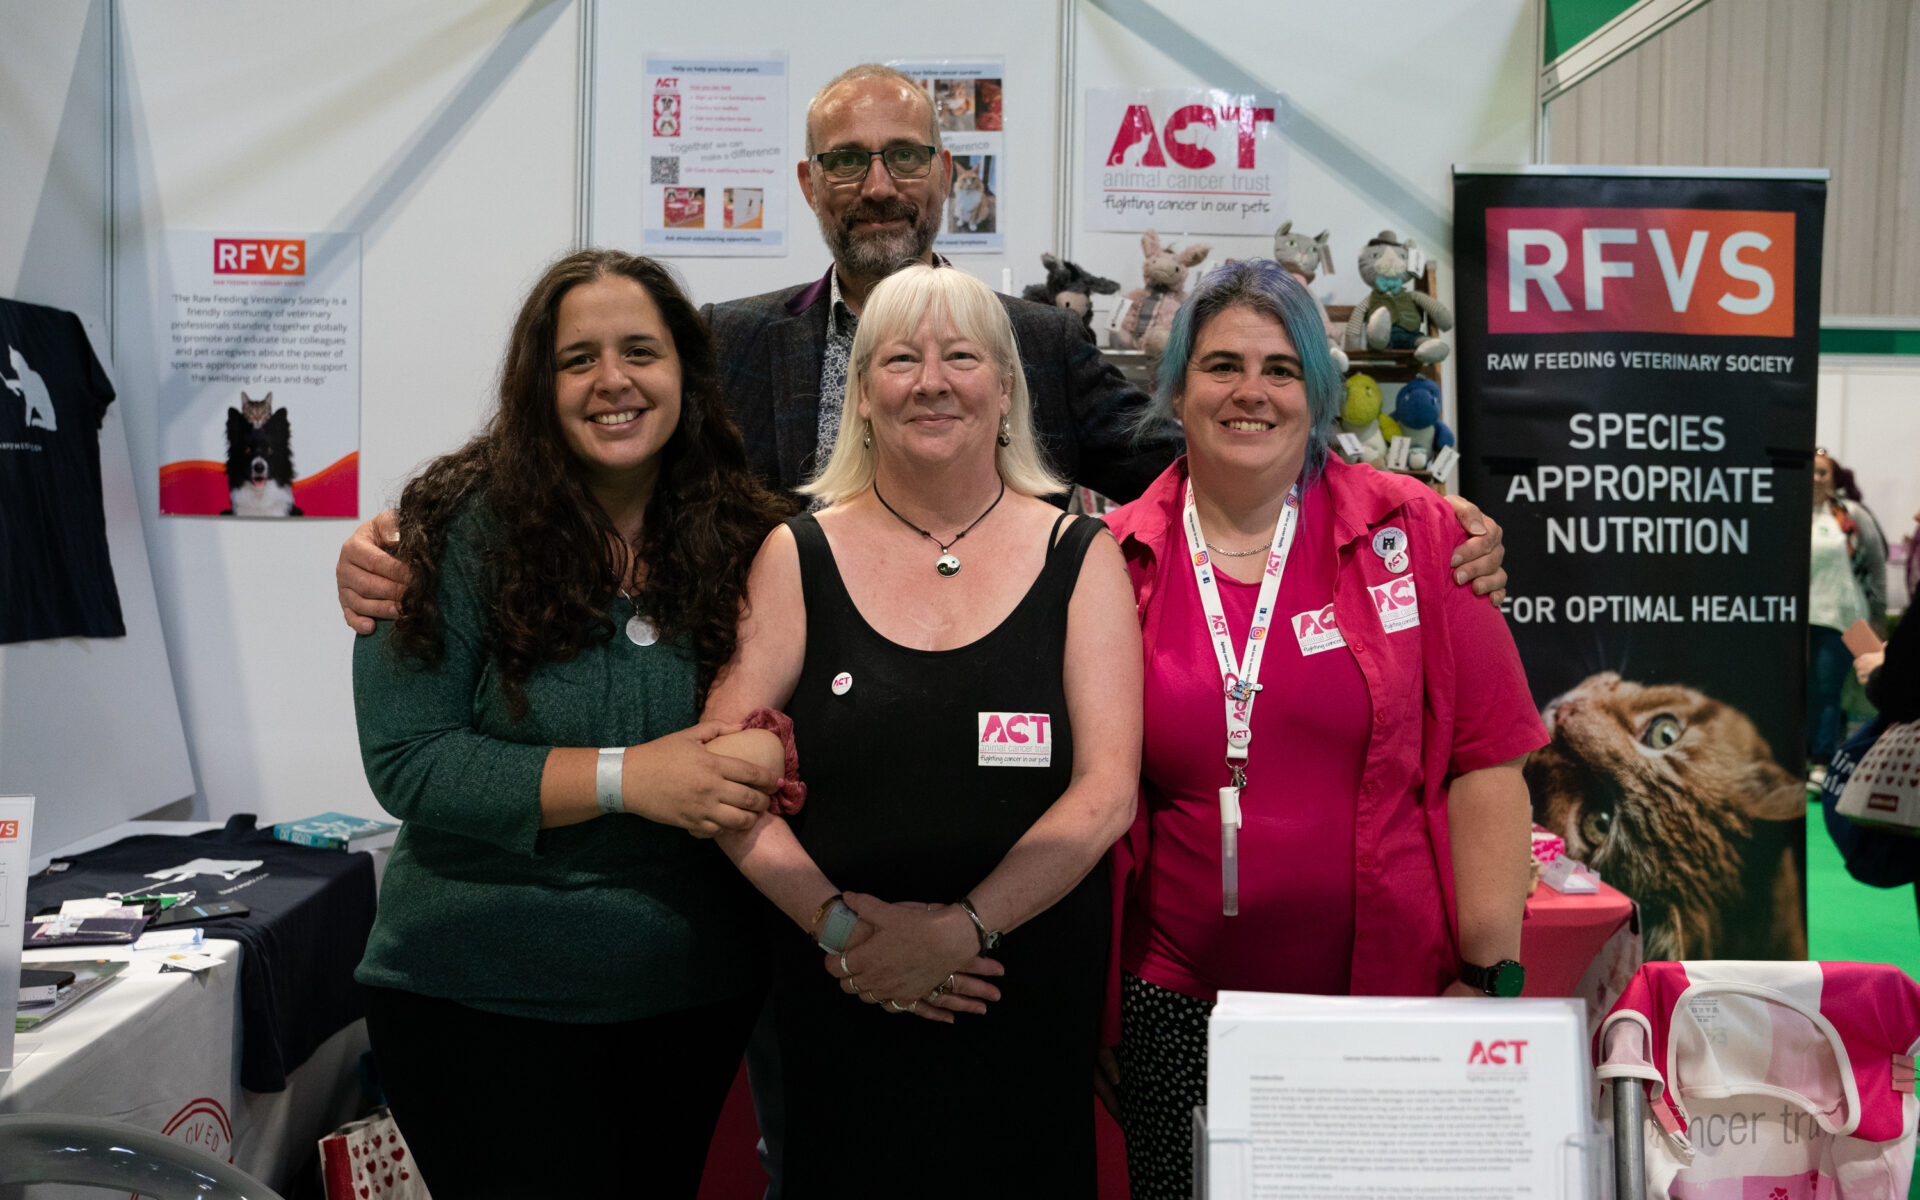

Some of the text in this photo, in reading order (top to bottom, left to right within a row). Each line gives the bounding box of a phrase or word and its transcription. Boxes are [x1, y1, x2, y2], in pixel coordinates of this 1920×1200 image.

[655, 77, 679, 88] ACT
[669, 142, 713, 154] Together
[1106, 104, 1275, 170] ACT
[730, 147, 781, 160] difference
[1103, 171, 1271, 191] animal cancer trust
[1103, 195, 1270, 219] fighting cancer in our pets
[219, 244, 300, 270] RFVS
[1507, 228, 1775, 315] RFVS
[192, 295, 211, 303] Raw
[213, 295, 248, 306] Feeding
[251, 296, 296, 306] Veterinary
[298, 296, 329, 307] Society
[332, 297, 340, 305] is
[187, 307, 331, 320] friendly community of veterinary
[171, 321, 347, 334] professionals standing together globally
[172, 336, 182, 344] to
[184, 336, 223, 346] promote
[224, 336, 241, 344] and
[244, 336, 279, 344] educate
[299, 336, 346, 347] colleagues
[175, 348, 344, 359] and pet caregivers about the power of
[1486, 351, 1794, 373] RAW FEEDING VETERINARY SOCIETY
[171, 360, 347, 372] species appropriate nutrition to support
[191, 374, 206, 382] the
[208, 374, 250, 385] wellbeing
[252, 375, 262, 383] of
[264, 375, 281, 383] cats
[283, 375, 301, 384] and
[1567, 413, 1726, 452] SPECIES
[1505, 464, 1774, 503] APPROPRIATE
[1546, 516, 1748, 555] NUTRITION
[1266, 552, 1282, 577] ACT
[1388, 552, 1403, 570] ACT
[1374, 576, 1415, 613] AC
[1565, 595, 1683, 623] OPTIMAL
[1691, 595, 1797, 623] HEALTH
[1211, 615, 1228, 637] ACT
[1299, 606, 1337, 639] AC
[833, 677, 850, 687] ACT
[1233, 700, 1247, 722] AC
[981, 714, 1049, 744] ACT
[1230, 730, 1248, 740] ACT
[980, 743, 1049, 754] animal cancer trust
[980, 755, 1003, 764] fighting
[1038, 757, 1049, 765] pets
[0, 823, 15, 836] VS
[1468, 1041, 1529, 1065] ACT
[185, 1122, 219, 1152] OVED
[1688, 1104, 1824, 1149] ncer tru
